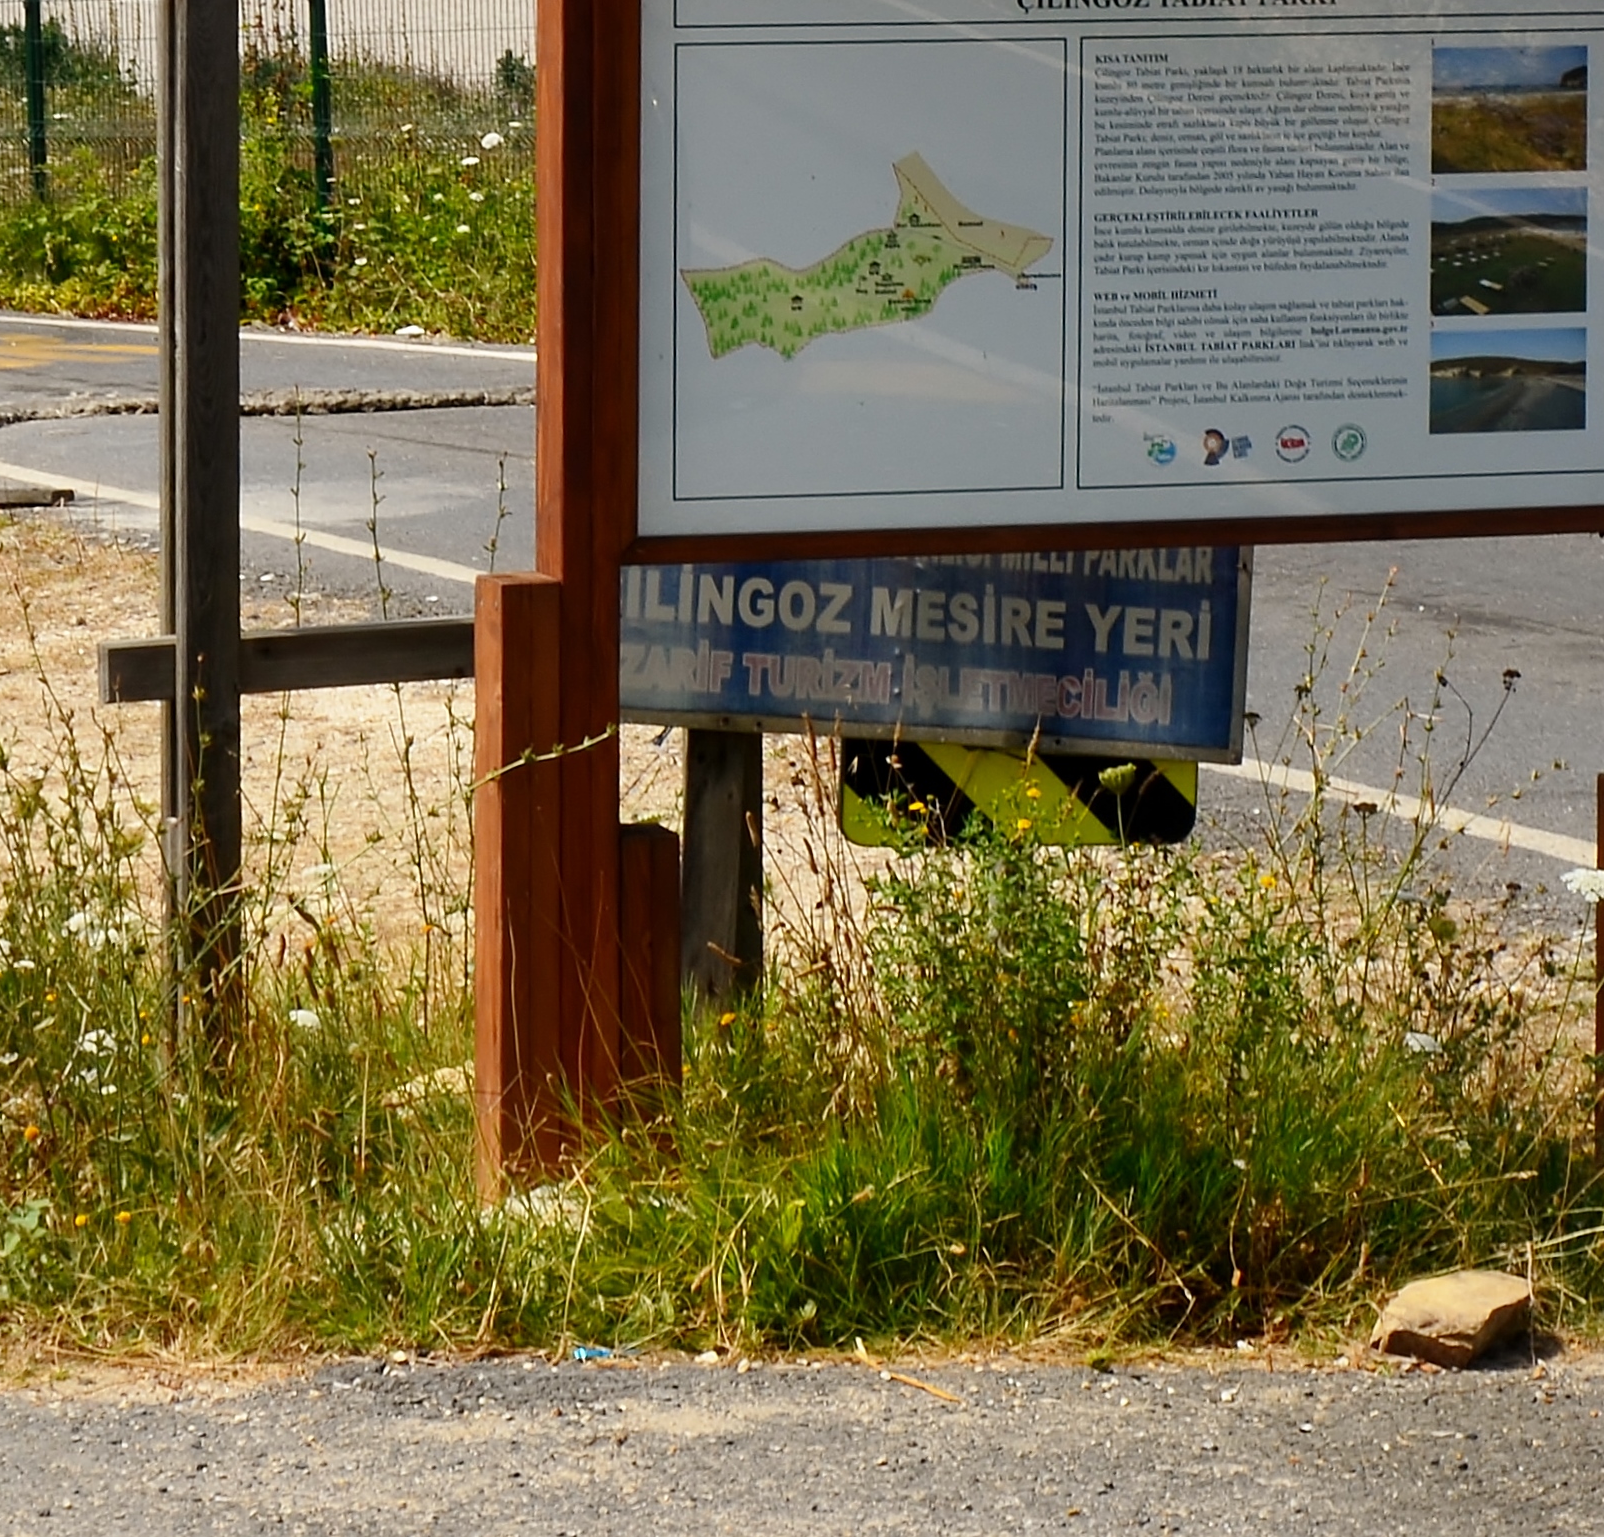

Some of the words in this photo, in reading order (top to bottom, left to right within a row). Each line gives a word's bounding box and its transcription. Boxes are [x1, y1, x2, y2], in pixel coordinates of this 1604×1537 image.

[869, 583, 1067, 650] MESİRE
[1084, 599, 1212, 661] YERİ
[742, 648, 892, 705] TURİZM
